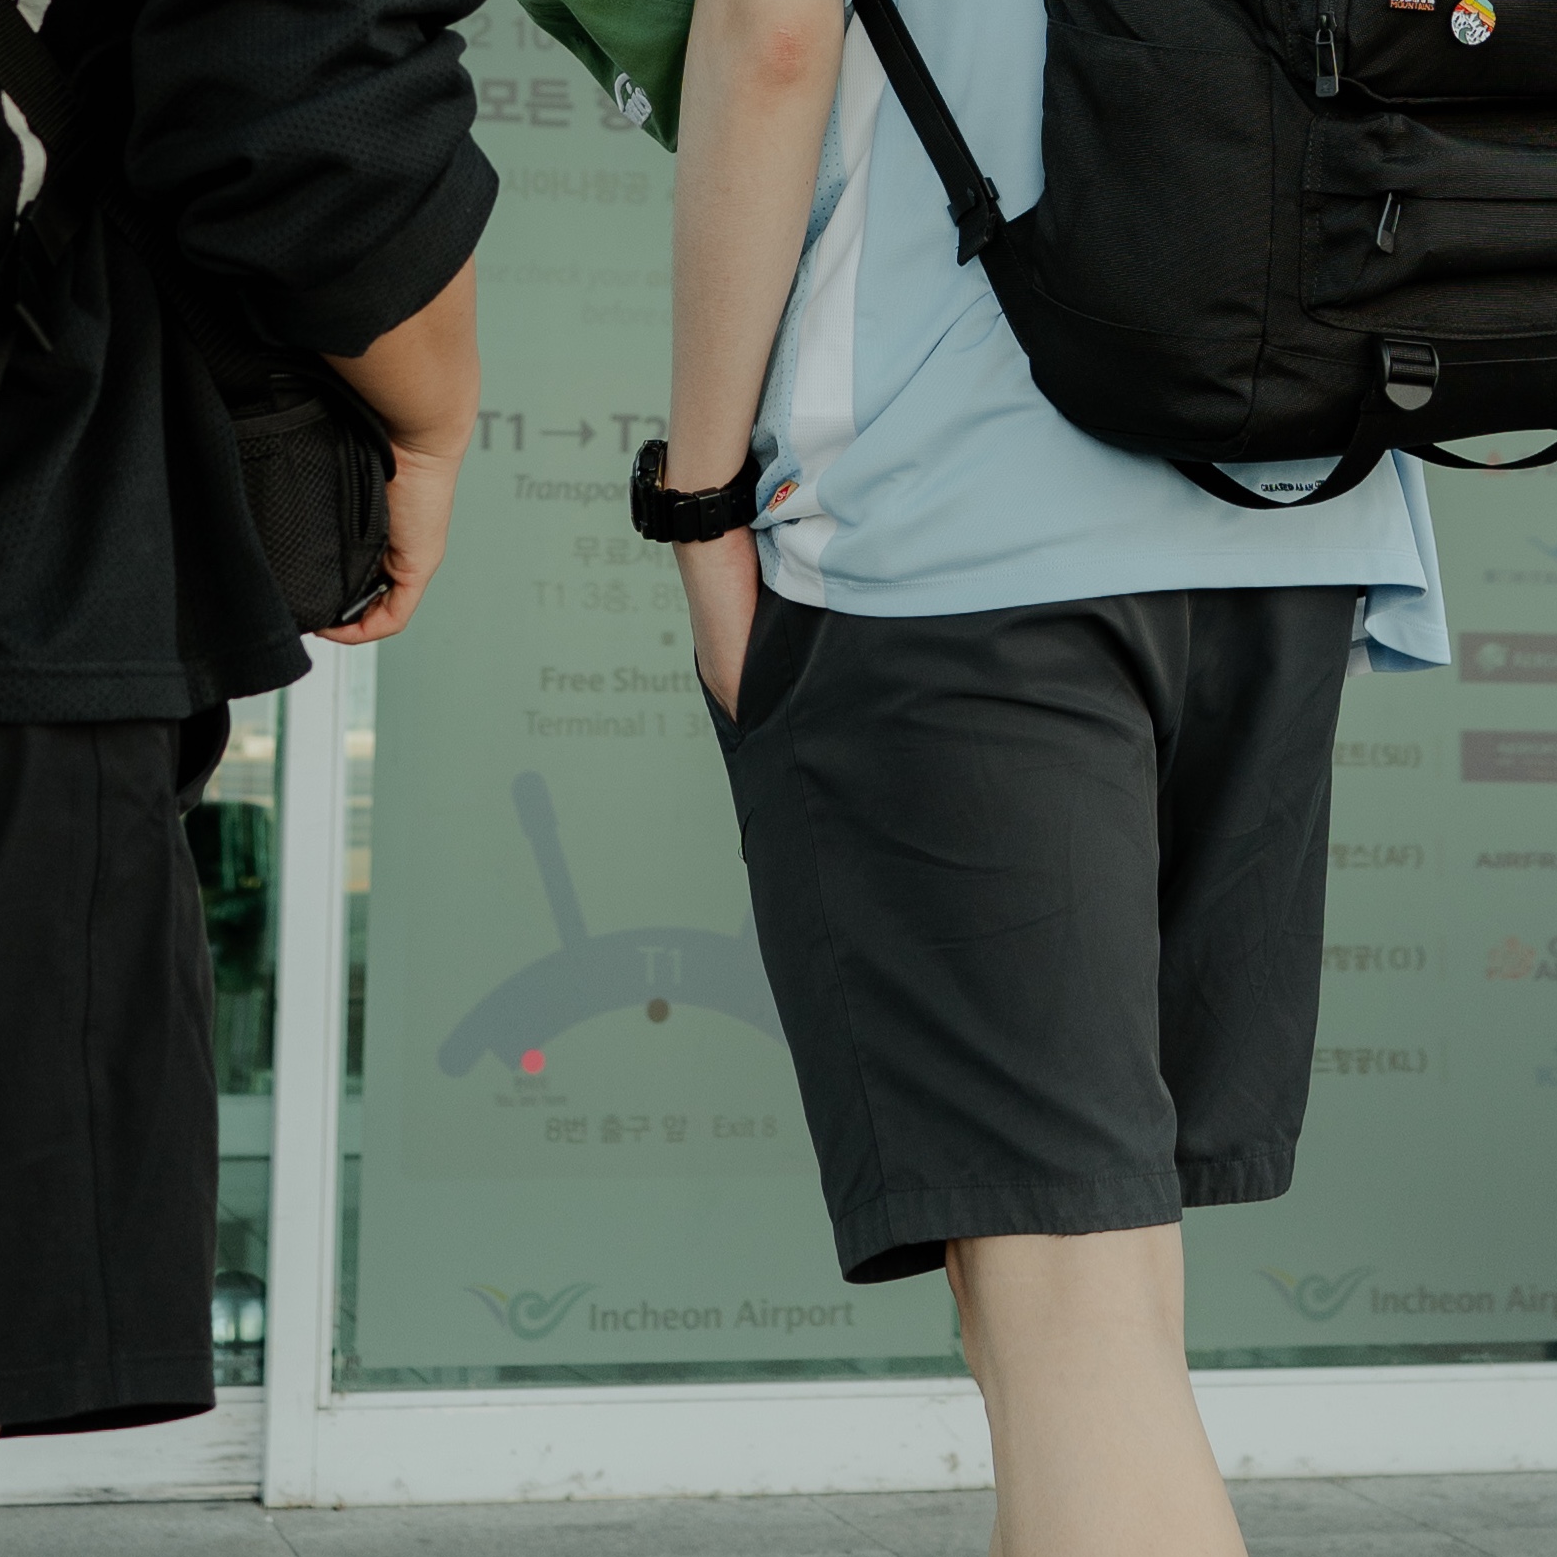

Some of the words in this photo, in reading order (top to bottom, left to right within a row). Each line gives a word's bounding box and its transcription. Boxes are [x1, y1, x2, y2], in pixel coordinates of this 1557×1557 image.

[1390, 0, 1435, 11] MOUNTAINS
[477, 77, 574, 128] 모든
[477, 410, 525, 453] T1
[513, 473, 627, 508] Transpor
[572, 535, 677, 569] 무료셔
[539, 666, 605, 693] Free
[612, 665, 701, 693] Shutt
[523, 710, 646, 738] Terminal
[636, 945, 683, 986] T1
[587, 1299, 725, 1332] Incheon
[733, 1298, 857, 1335] Airport
[1370, 1288, 1493, 1315] Incheon
